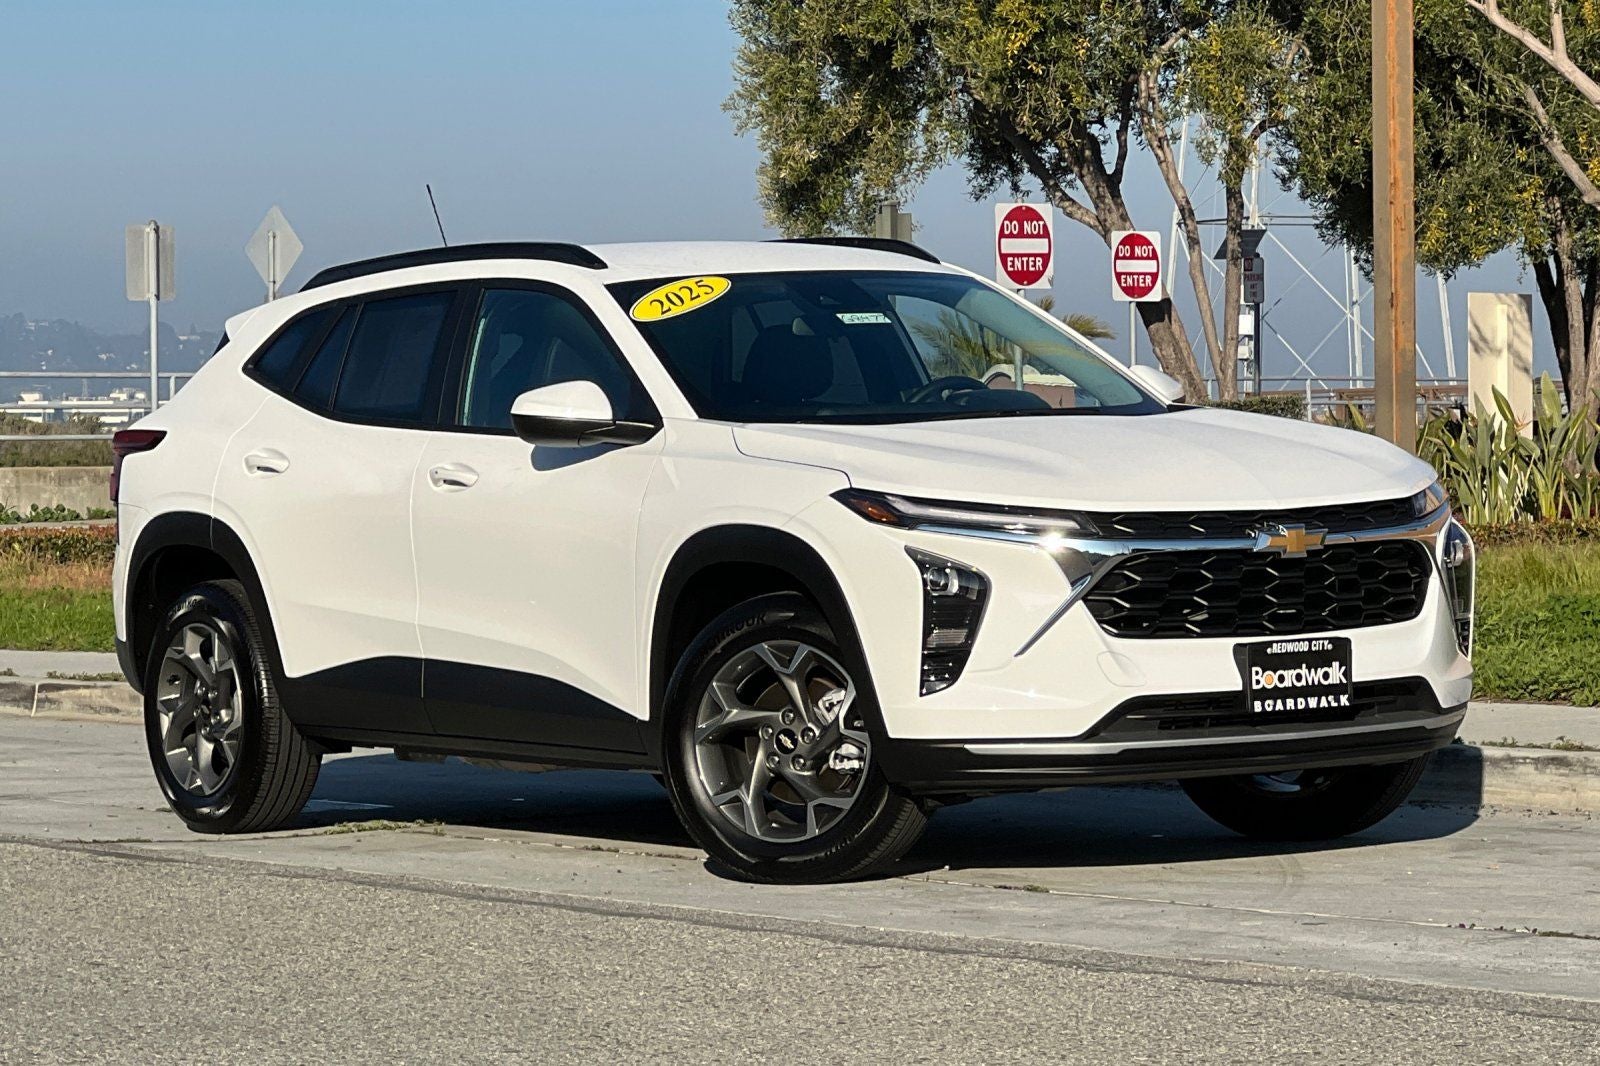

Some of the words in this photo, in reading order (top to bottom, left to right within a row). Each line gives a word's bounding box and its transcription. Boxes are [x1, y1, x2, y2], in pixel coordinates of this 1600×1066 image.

[1003, 220, 1019, 235] DO
[1023, 220, 1045, 235] NOT
[1118, 245, 1130, 257] DO
[1134, 245, 1153, 257] NOT
[1007, 257, 1043, 271] ENTER
[1120, 275, 1152, 287] ENTER
[649, 279, 715, 315] 2025
[1271, 640, 1309, 654] REDWOOD
[1311, 640, 1330, 651] CITY
[1251, 661, 1348, 690] Boardwalk
[1253, 694, 1350, 712] BOARDWALK
